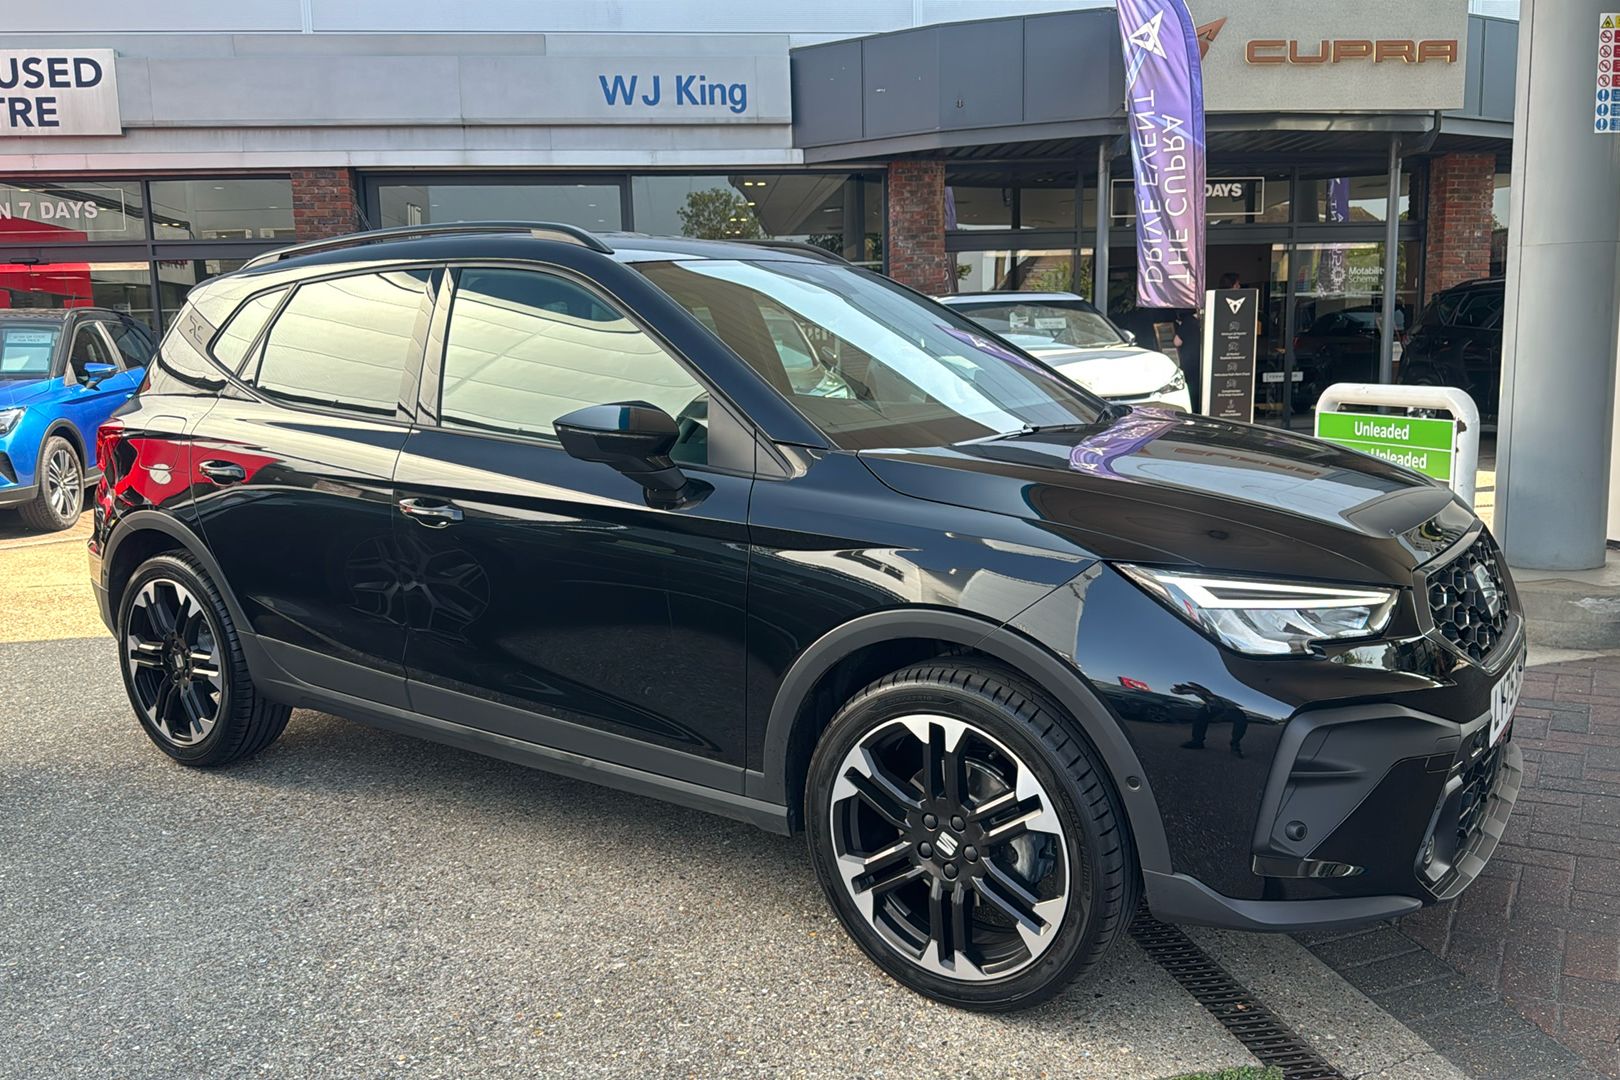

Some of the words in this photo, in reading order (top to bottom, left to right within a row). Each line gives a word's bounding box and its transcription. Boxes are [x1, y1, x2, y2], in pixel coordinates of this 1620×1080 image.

[1245, 39, 1458, 64] CUPRA
[0, 57, 103, 89] USED
[675, 75, 747, 114] King
[19, 202, 31, 219] 7
[40, 201, 98, 219] DAYS
[1354, 421, 1410, 440] Unleaded
